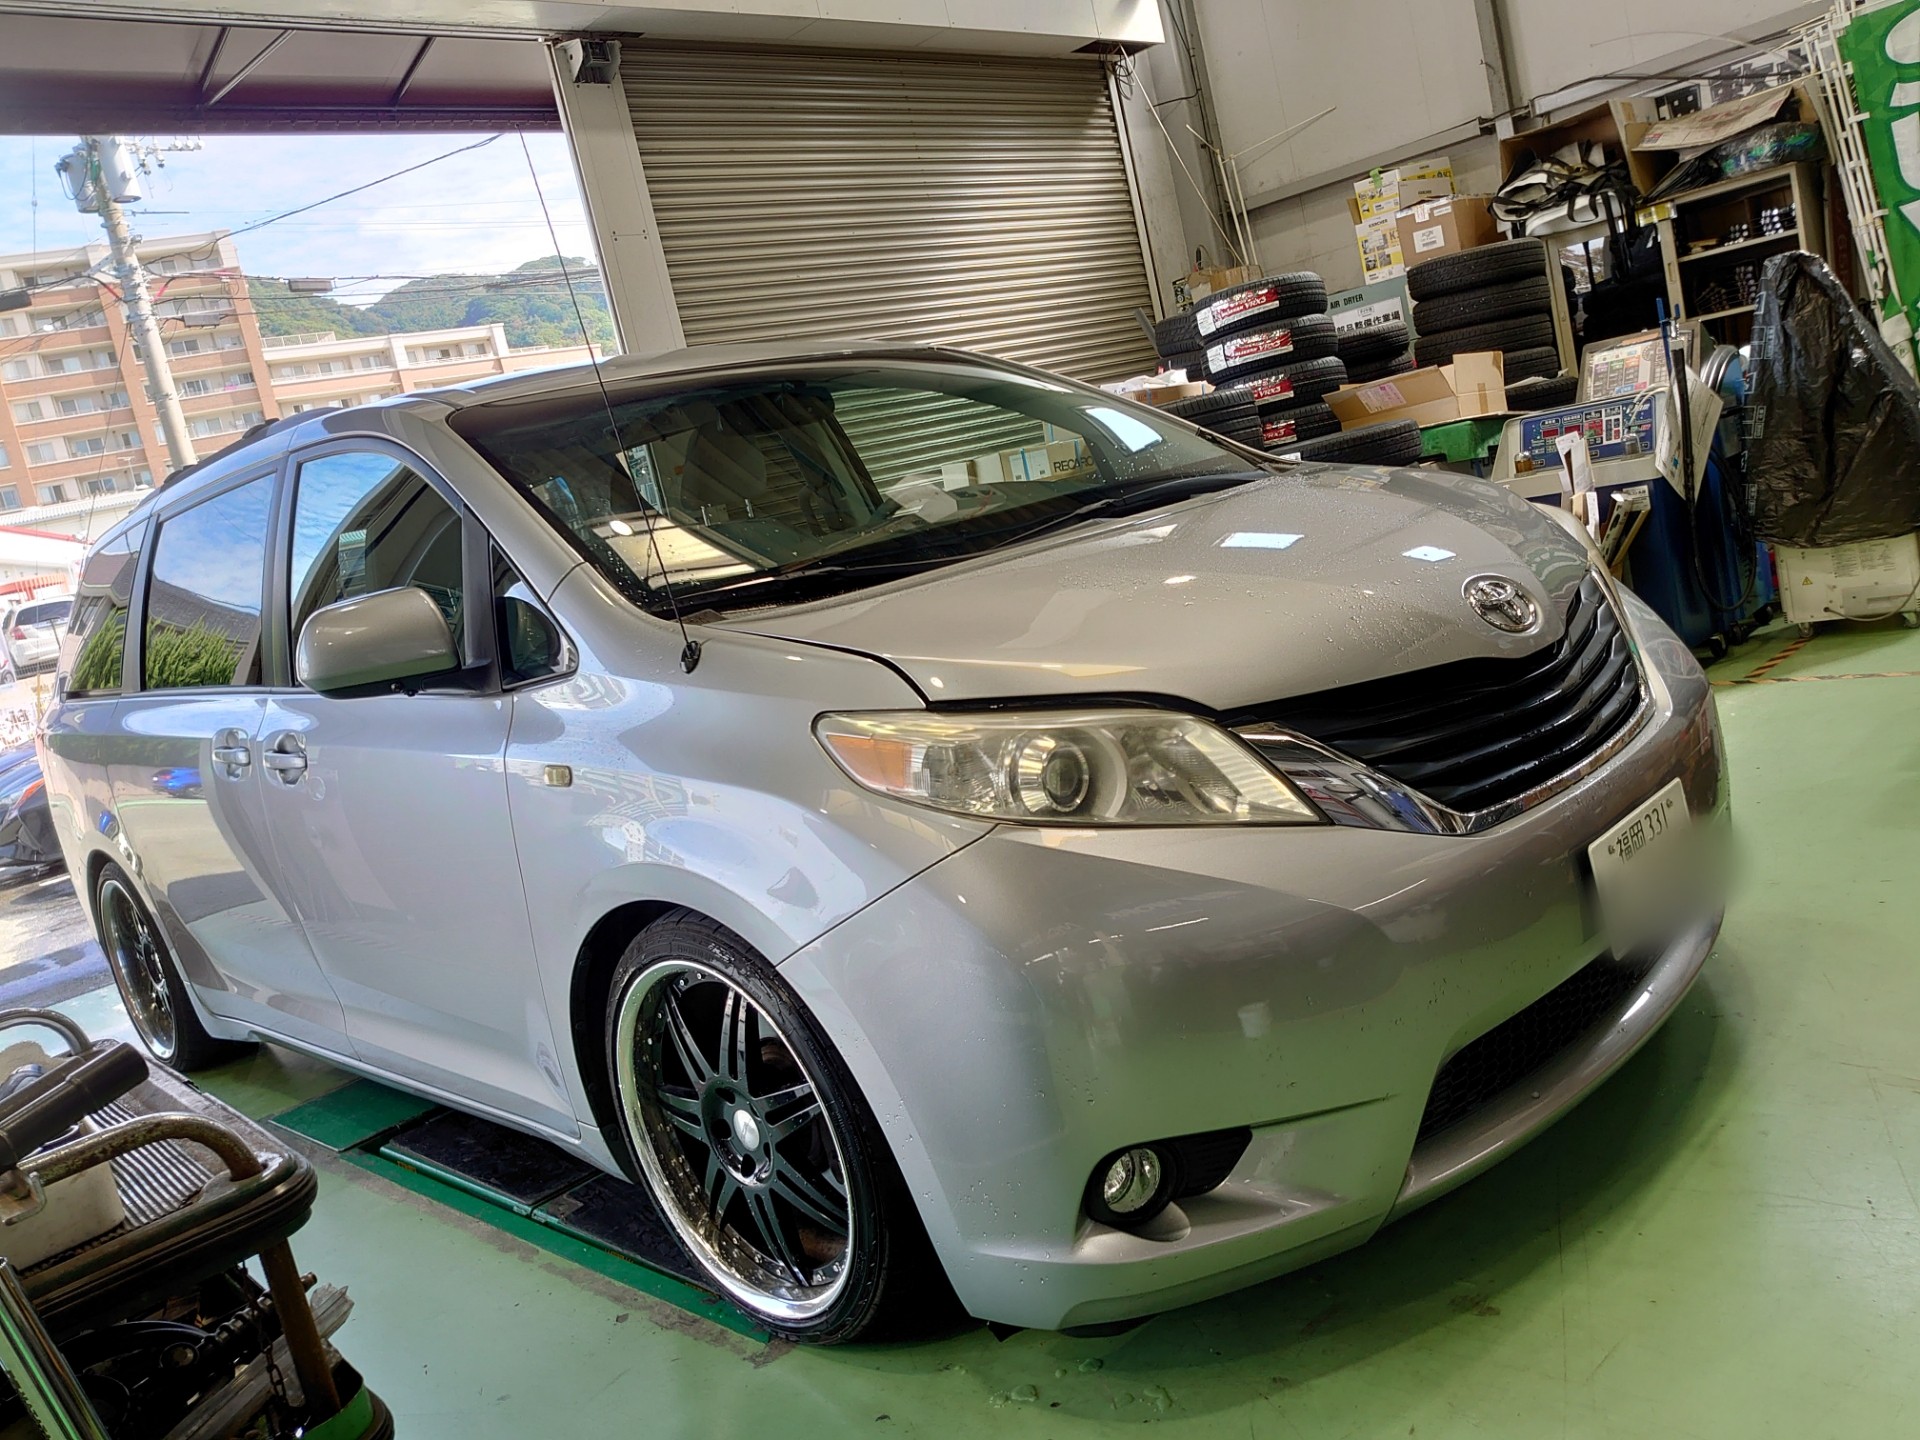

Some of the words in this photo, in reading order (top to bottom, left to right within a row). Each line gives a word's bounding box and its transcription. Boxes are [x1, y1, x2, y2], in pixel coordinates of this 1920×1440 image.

[1245, 296, 1267, 309] VRX3
[1330, 301, 1341, 310] AIR
[1343, 293, 1364, 306] DRYER
[1259, 386, 1281, 398] VRX3
[1053, 455, 1095, 473] RECARO
[1616, 819, 1647, 864] 福岡
[1644, 802, 1669, 841] 331
